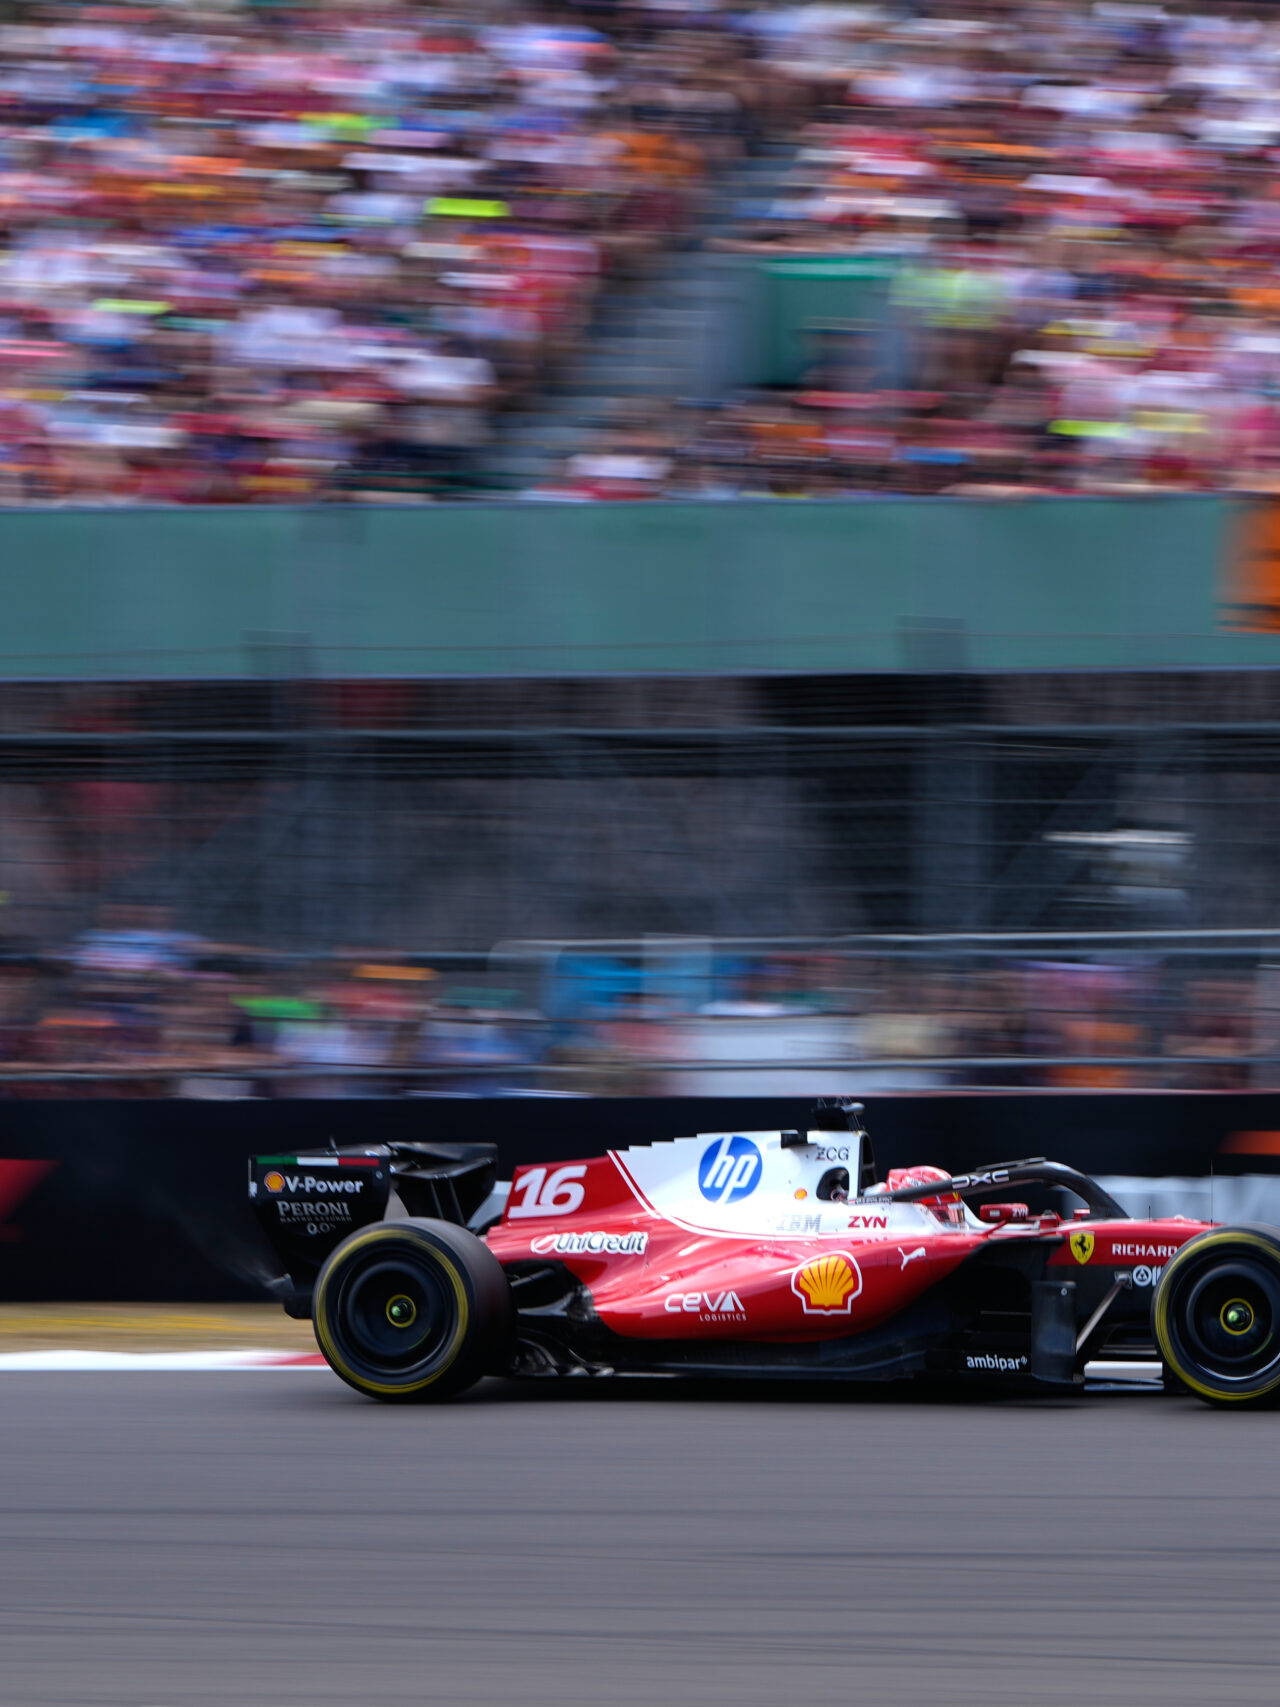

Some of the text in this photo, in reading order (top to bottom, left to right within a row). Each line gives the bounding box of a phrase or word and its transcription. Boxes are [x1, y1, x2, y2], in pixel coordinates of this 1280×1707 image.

[703, 1134, 758, 1204] hp
[285, 1176, 364, 1193] V-Power
[952, 1169, 1010, 1189] DXC
[507, 1165, 588, 1219] 16
[276, 1200, 352, 1217] PERONI
[848, 1216, 887, 1229] ZYN
[555, 1231, 648, 1254] UniCredit
[1112, 1243, 1178, 1257] RICHARD
[699, 1313, 747, 1322] LOGISTICS
[966, 1354, 1020, 1371] ambipar
